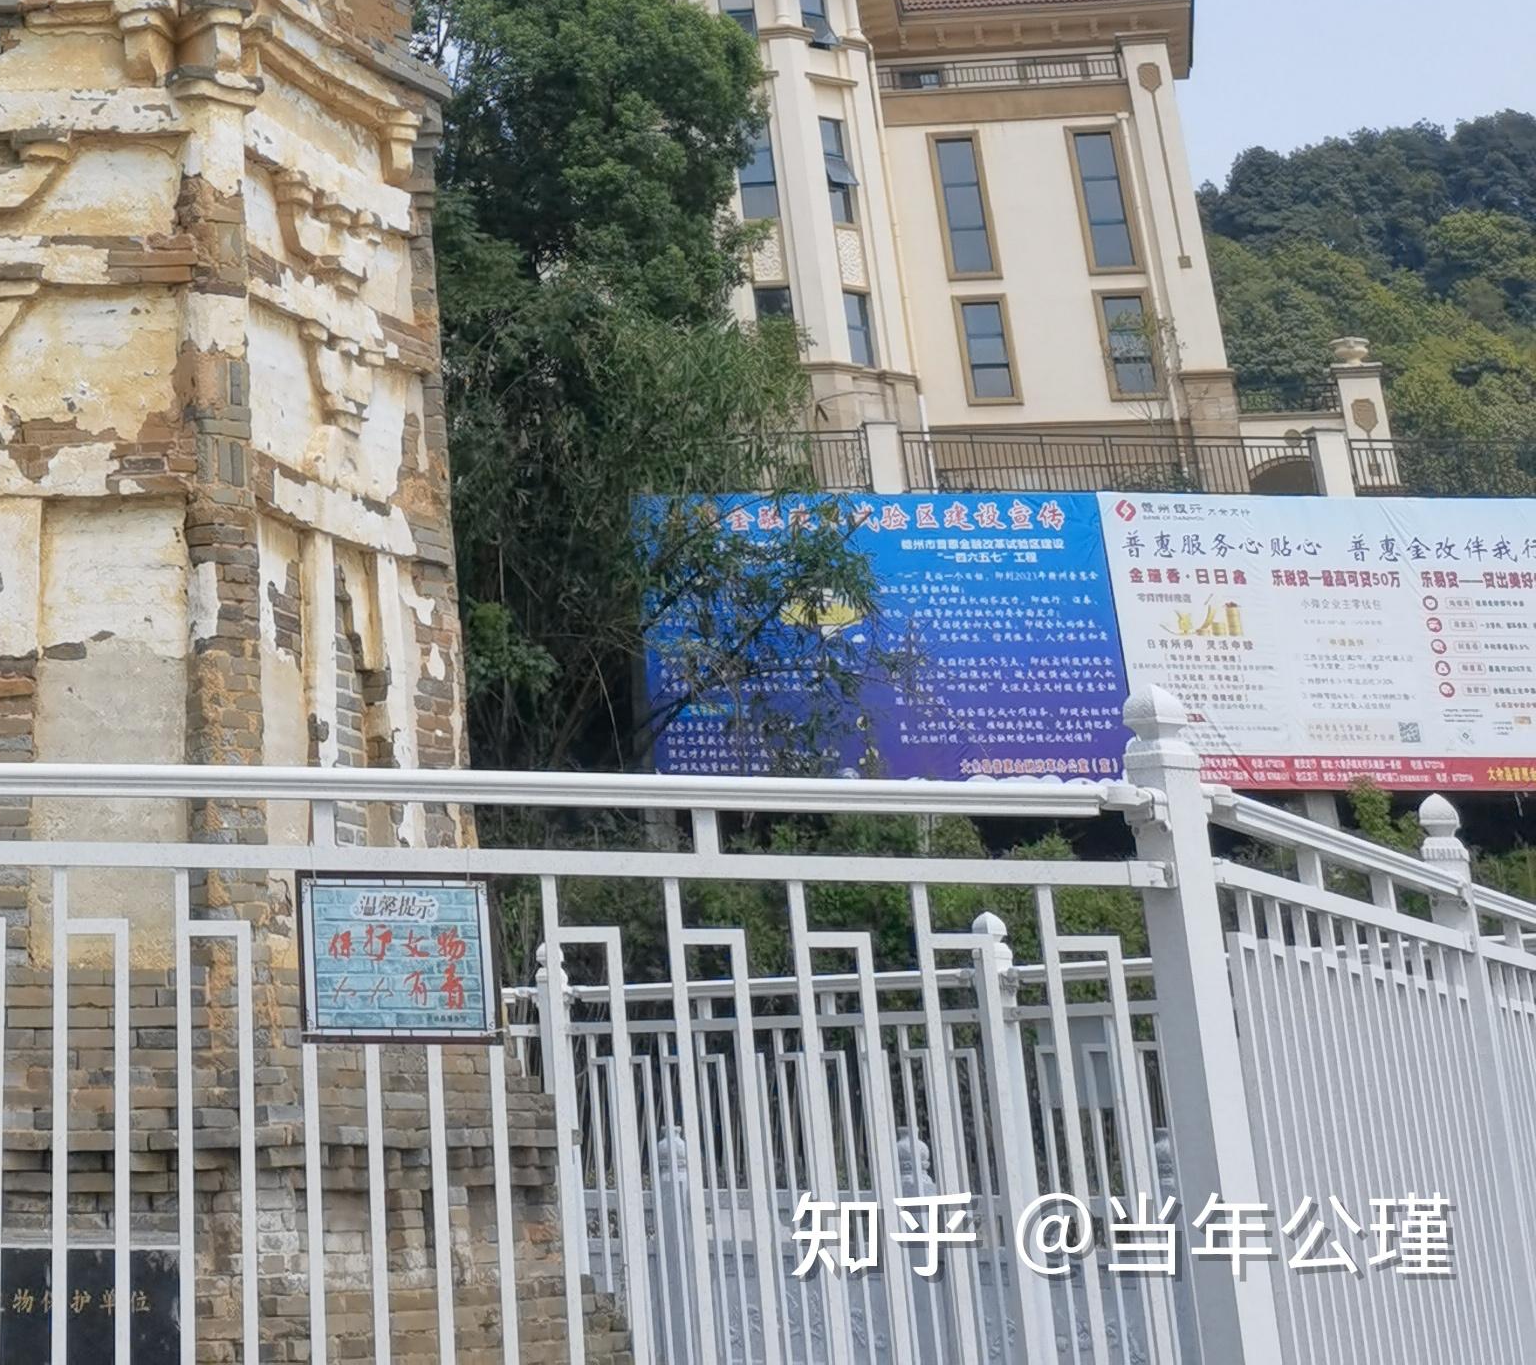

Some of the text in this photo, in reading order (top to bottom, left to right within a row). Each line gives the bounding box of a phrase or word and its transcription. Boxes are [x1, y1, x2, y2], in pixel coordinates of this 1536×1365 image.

[1121, 529, 1536, 563] 普惠服务心贴心 普惠金改伴我行
[358, 894, 436, 920] 温馨提示
[328, 923, 467, 962] 保护文物
[332, 963, 464, 1011] 人人有责
